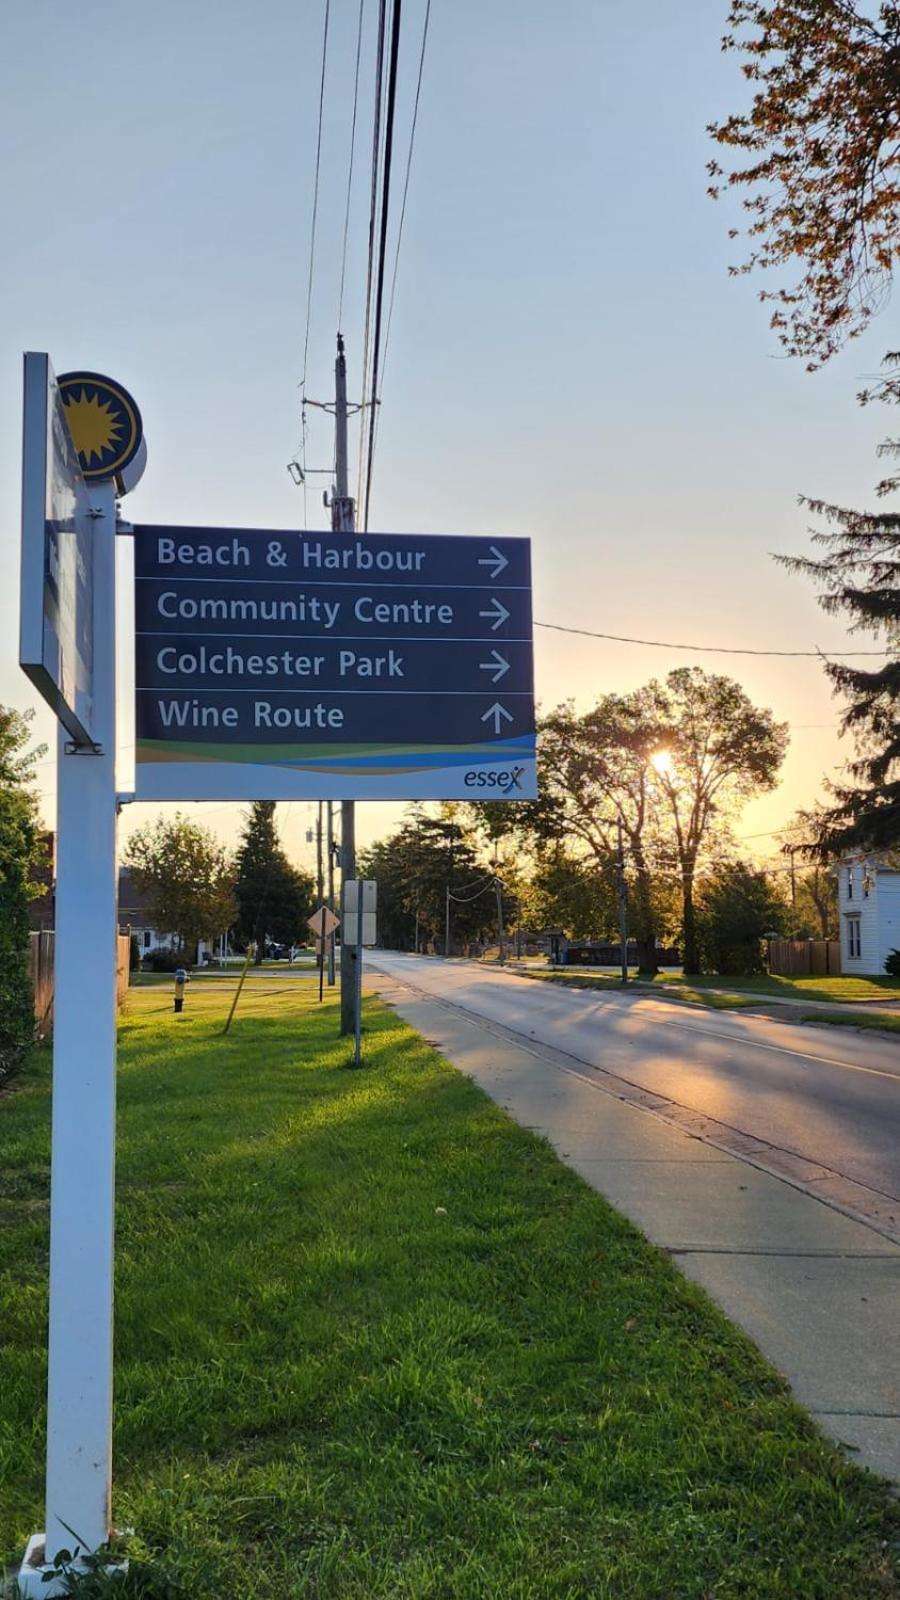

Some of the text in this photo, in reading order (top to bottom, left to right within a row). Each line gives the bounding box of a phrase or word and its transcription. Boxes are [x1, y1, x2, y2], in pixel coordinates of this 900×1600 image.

[157, 538, 426, 571] Beach & Harbour
[157, 592, 454, 628] Community Centre
[156, 647, 404, 677] Colchester Park
[158, 700, 344, 728] Wine Route
[464, 766, 525, 794] essex
